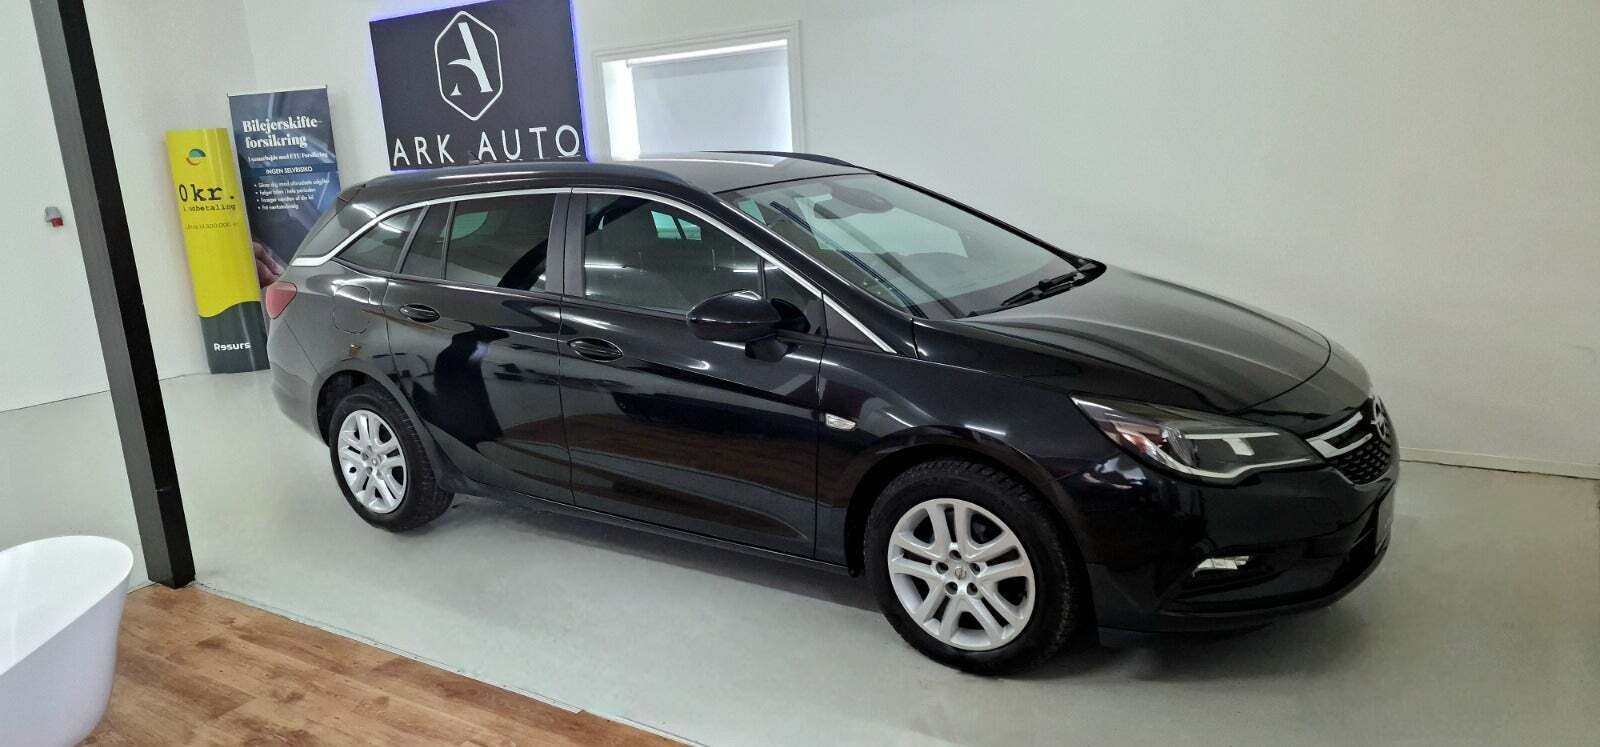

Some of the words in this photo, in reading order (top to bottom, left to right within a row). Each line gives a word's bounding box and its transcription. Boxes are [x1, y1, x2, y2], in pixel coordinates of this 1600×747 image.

[245, 133, 308, 149] forsikring
[392, 133, 455, 167] ARK
[477, 124, 580, 161] AUTO
[190, 183, 235, 202] kr.
[213, 342, 251, 352] Resurs
